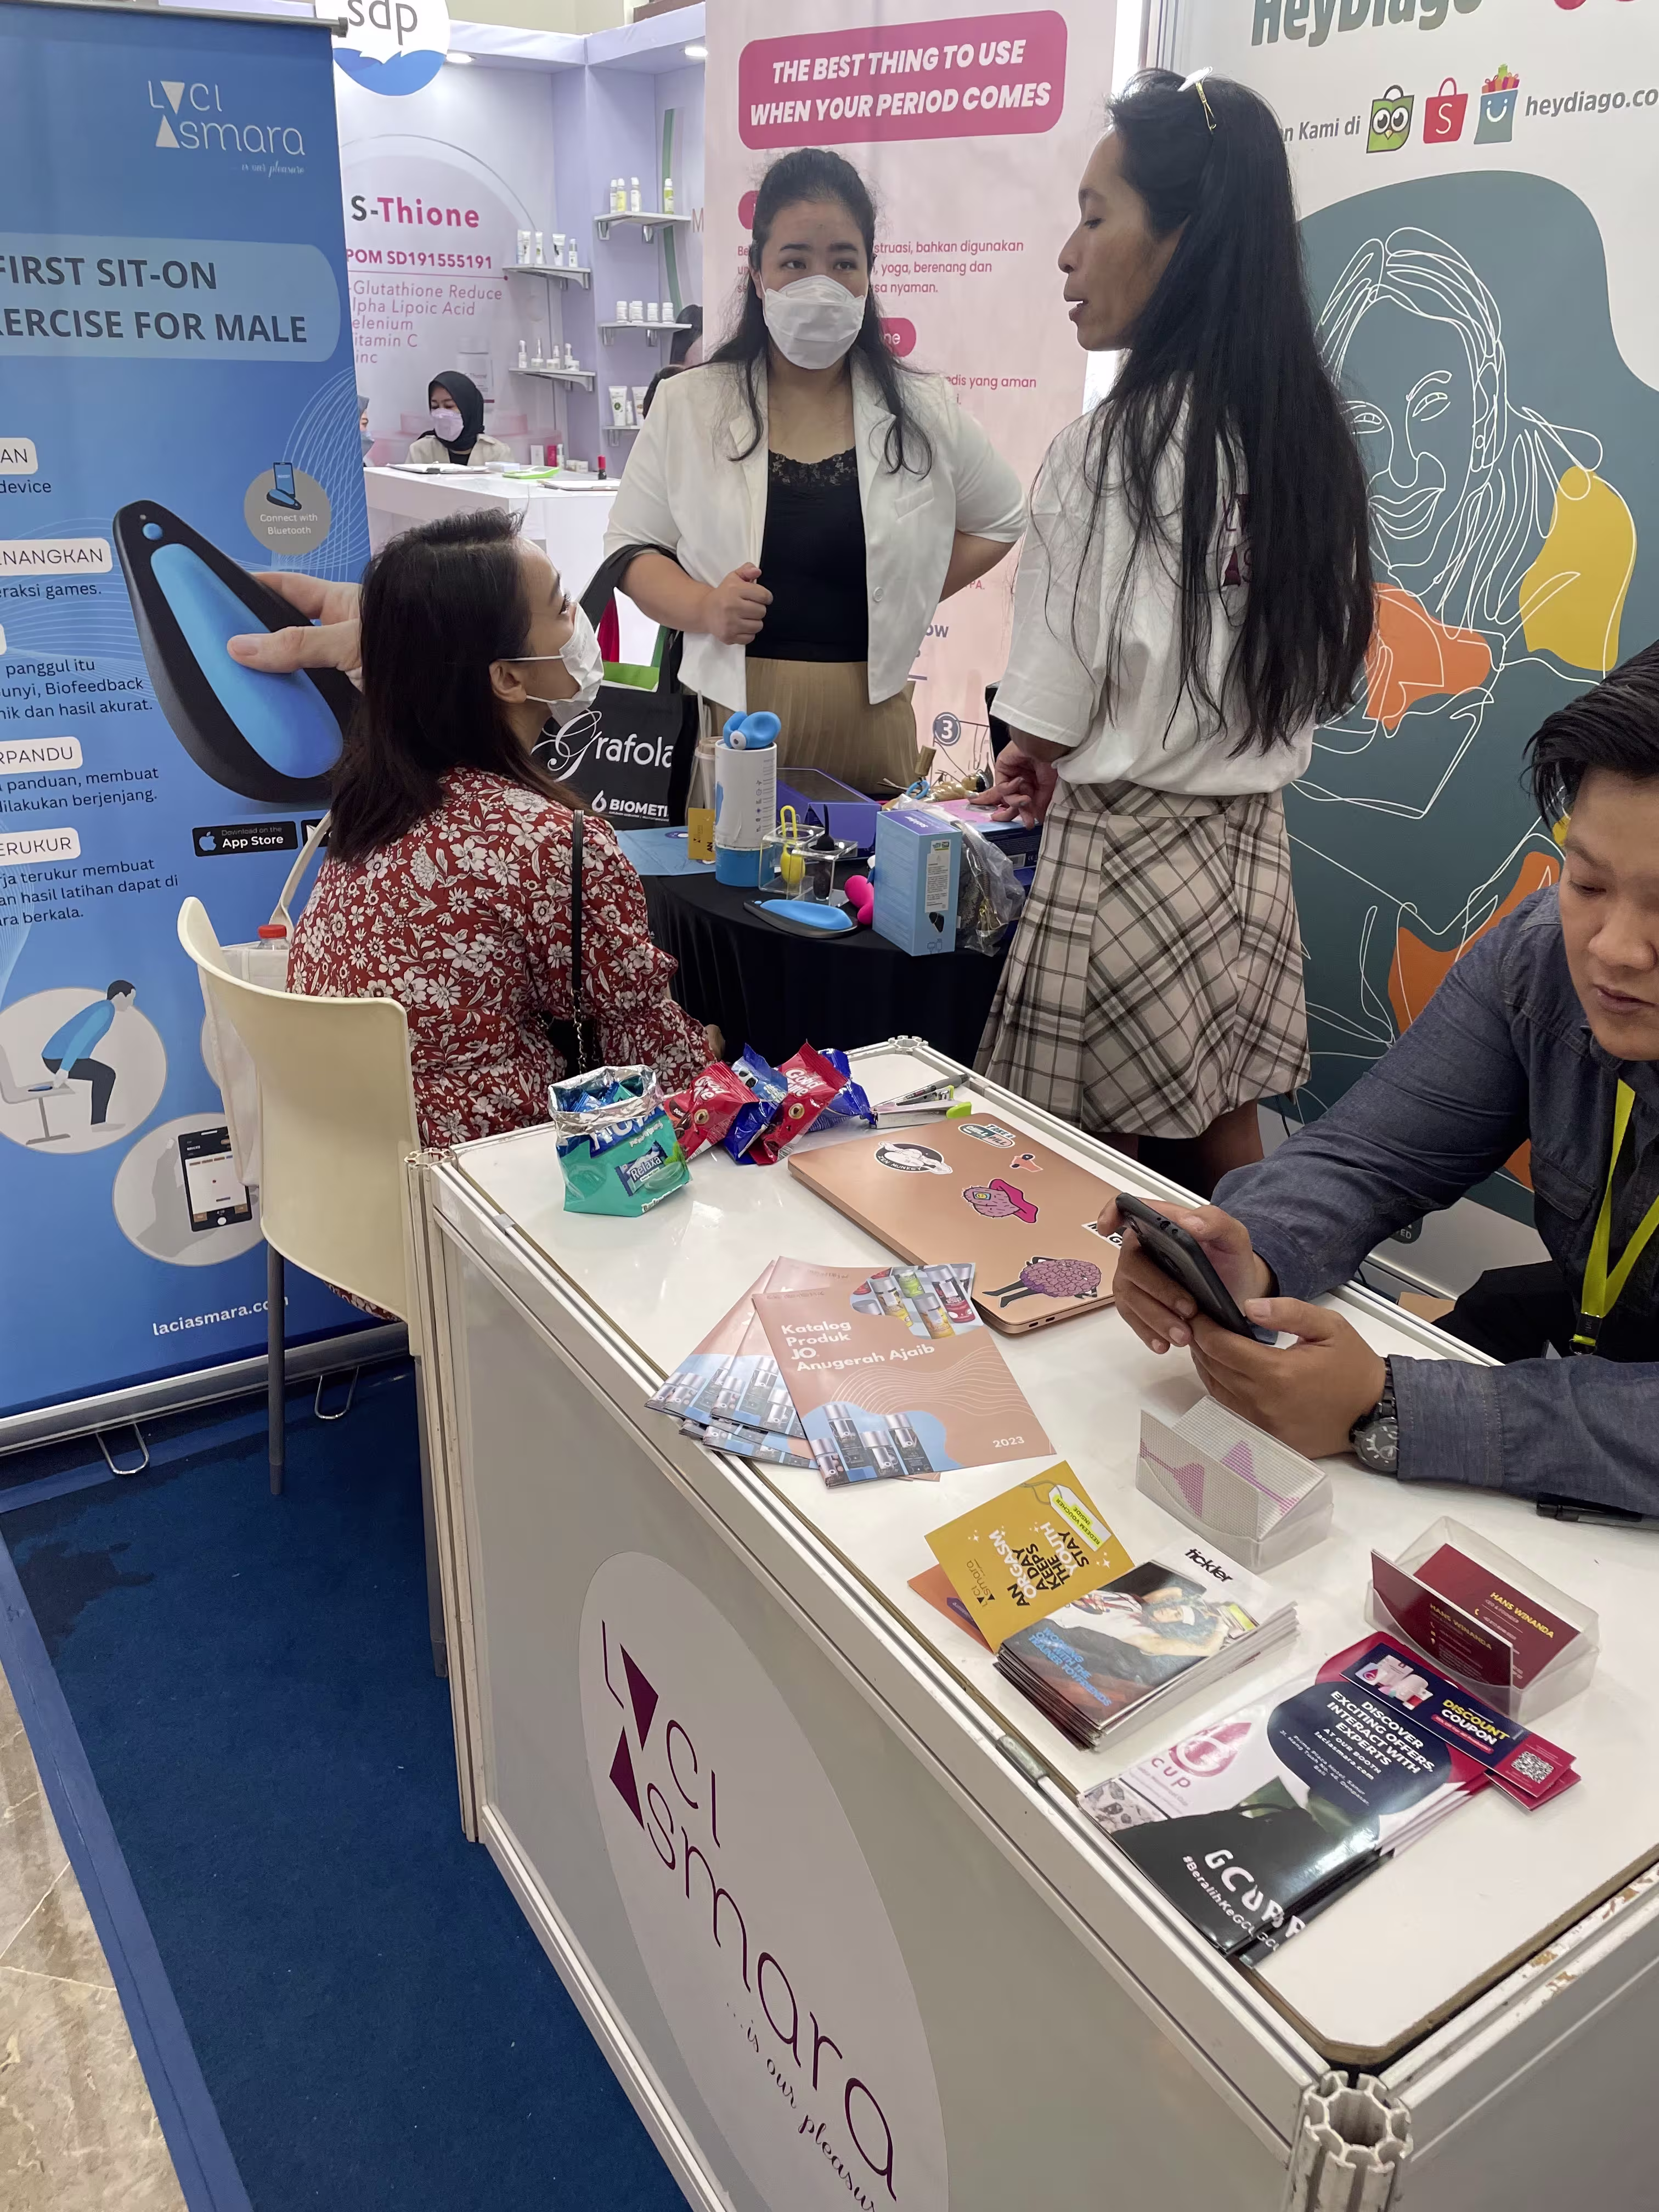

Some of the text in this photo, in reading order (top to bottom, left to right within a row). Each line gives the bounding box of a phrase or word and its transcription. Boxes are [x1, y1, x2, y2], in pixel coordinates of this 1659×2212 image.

[773, 39, 1026, 84] THE BEST THING TO USE
[751, 82, 1052, 126] WHEN YOUR PERIOD COMES
[1299, 115, 1361, 142] Kami di
[351, 195, 479, 228] S-Thione
[387, 251, 492, 269] SD191555191
[916, 240, 957, 254] bahkan
[960, 239, 1024, 256] digunakan
[97, 258, 217, 290] SIT-ON
[881, 263, 911, 276] yoga,
[913, 262, 966, 276] berenang
[969, 261, 992, 273] dan
[448, 284, 503, 300] Reduce
[890, 283, 938, 296] nyaman.
[392, 298, 437, 318] Lipoic
[442, 301, 476, 316] Acid
[0, 308, 308, 343] ERCISE FOR MALE
[352, 315, 414, 330] elenium
[353, 331, 418, 348] itamin C
[969, 375, 998, 390] yang
[1001, 376, 1037, 388] aman
[259, 513, 319, 522] Connect with
[267, 526, 312, 535] Bluetooth
[0, 548, 103, 566] NANGKAN
[0, 584, 102, 600] raksi games.
[5, 659, 95, 679] panggul itu
[0, 677, 144, 700] unyi, Biofeedback
[25, 699, 153, 719] dan hasil akurat.
[941, 719, 953, 740] 3
[7, 768, 159, 794] panduan, membuat
[72, 789, 157, 808] berjenjang.
[222, 835, 284, 850] App Store
[0, 858, 155, 889] ja terukur membuat
[21, 889, 58, 904] hasil
[61, 883, 114, 900] latihan
[117, 877, 162, 894] dapat
[165, 874, 179, 888] di
[23, 906, 84, 924] berkala.
[965, 1125, 989, 1137] CHILL
[987, 1124, 1007, 1136] TAKE
[988, 1135, 1008, 1146] PILL
[630, 1155, 663, 1182] Relaxa
[877, 1155, 923, 1171] ZEN MUNKEY
[153, 1296, 289, 1336] laciasmara.co
[781, 1321, 852, 1335] Katalog
[785, 1331, 852, 1346] Produk
[796, 1343, 935, 1372] Anugerah Ajaib
[992, 1435, 1026, 1448] 2023
[1056, 1498, 1101, 1545] REDEEM VOUCHER
[1073, 1506, 1091, 1526] INSIDE
[1040, 1521, 1078, 1576] YOUTH
[1057, 1531, 1090, 1567] STAY
[988, 1529, 1037, 1599] ORGASM
[1011, 1548, 1040, 1580] DAY
[1025, 1543, 1060, 1590] KEEPS
[1047, 1554, 1070, 1585] THE
[1184, 1548, 1234, 1583] tickler
[1007, 1583, 1031, 1607] AN
[1489, 1592, 1515, 1610] HANS
[1514, 1607, 1555, 1639] WINANDA
[1330, 1690, 1387, 1734] EXCITING
[1385, 1732, 1436, 1773] OFFERS,
[1361, 1701, 1424, 1750] DISCOVER
[1441, 1708, 1498, 1746] COUPON
[1442, 1699, 1511, 1740] DISCOUNT
[1326, 1701, 1422, 1775] INTERACT WITH
[1335, 1721, 1392, 1767] EXPERTS
[1313, 1731, 1375, 1781] laciasmara.com
[1335, 1736, 1353, 1752] OUR
[1352, 1751, 1383, 1774] BOOTH
[766, 2058, 797, 2109] our
